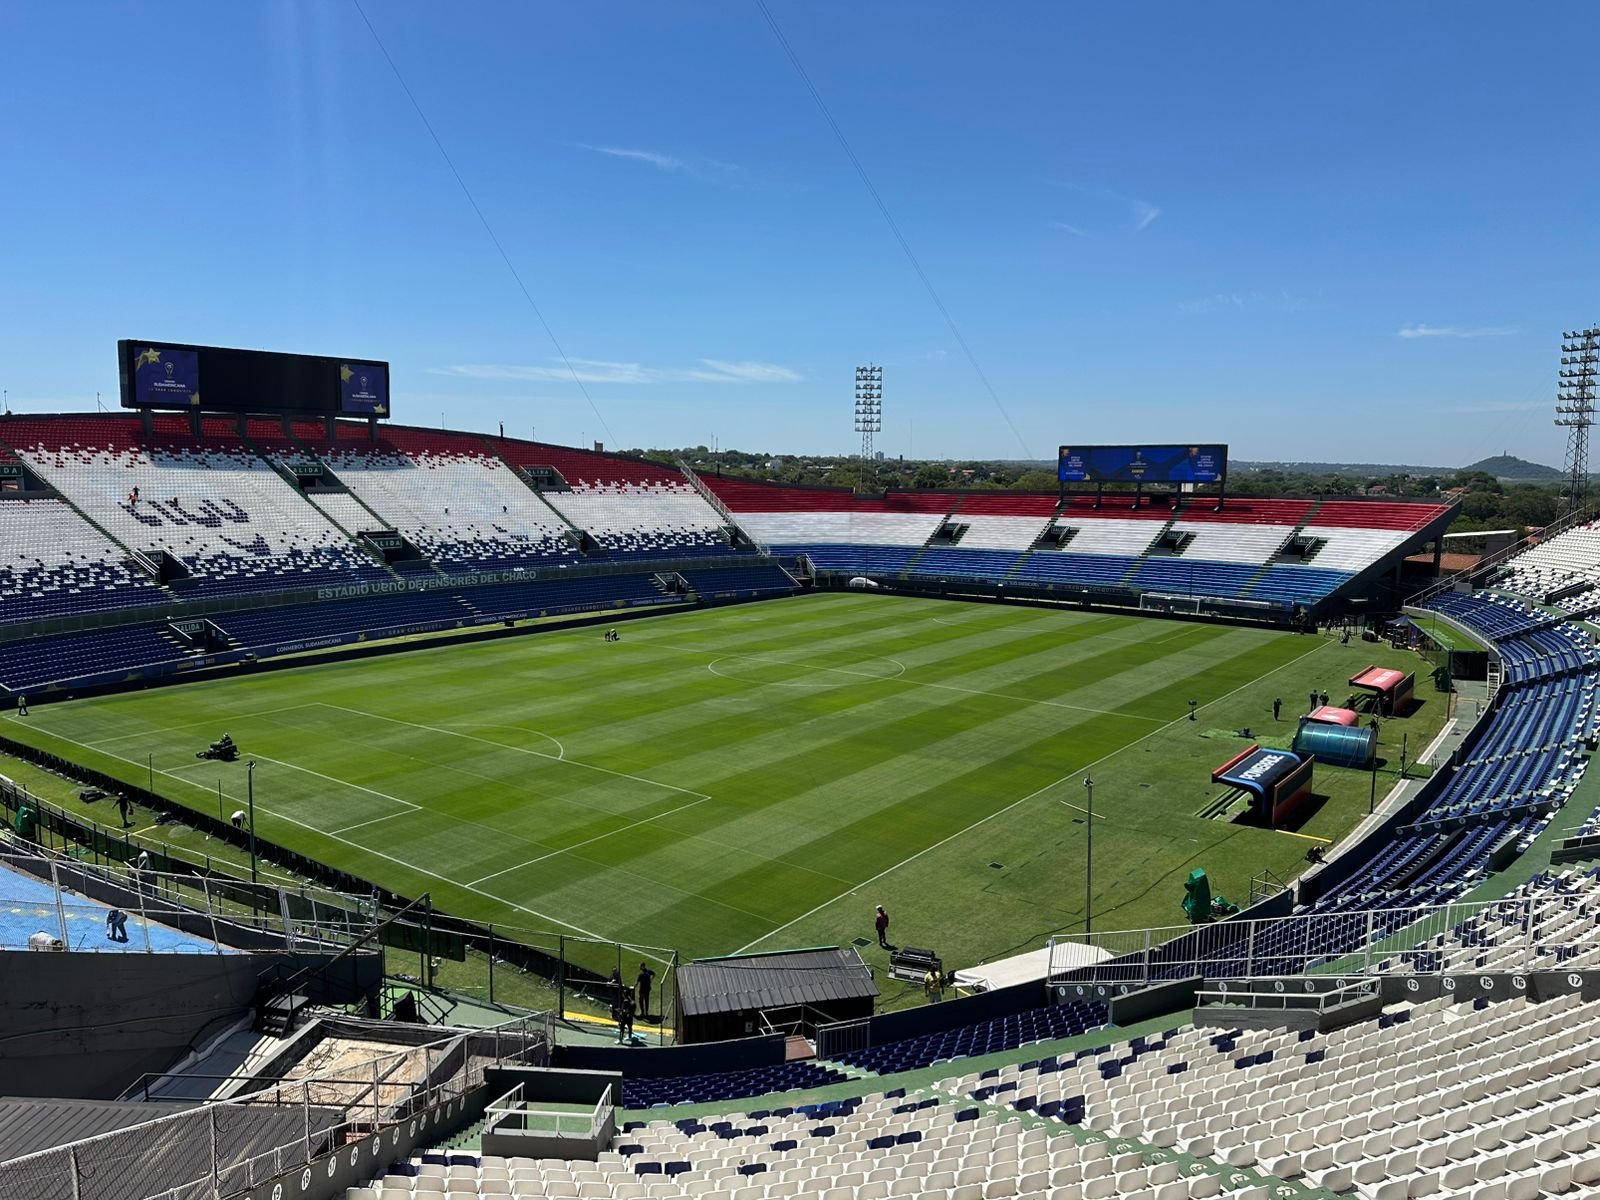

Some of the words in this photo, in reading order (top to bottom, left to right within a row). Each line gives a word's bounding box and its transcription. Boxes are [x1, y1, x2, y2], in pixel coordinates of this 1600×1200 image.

[317, 585, 369, 599] ESTADIO
[408, 575, 478, 590] DEFENSORES
[480, 574, 500, 584] DEL
[502, 570, 537, 581] CHACO
[276, 644, 304, 653] CONMEBOL
[306, 638, 342, 649] SUDAMERICANA
[1238, 754, 1285, 781] POWERADE
[1408, 980, 1418, 990] 13
[1444, 978, 1454, 989] 14
[1481, 977, 1492, 988] 15
[1513, 977, 1525, 988] 16
[1569, 975, 1581, 986] 17
